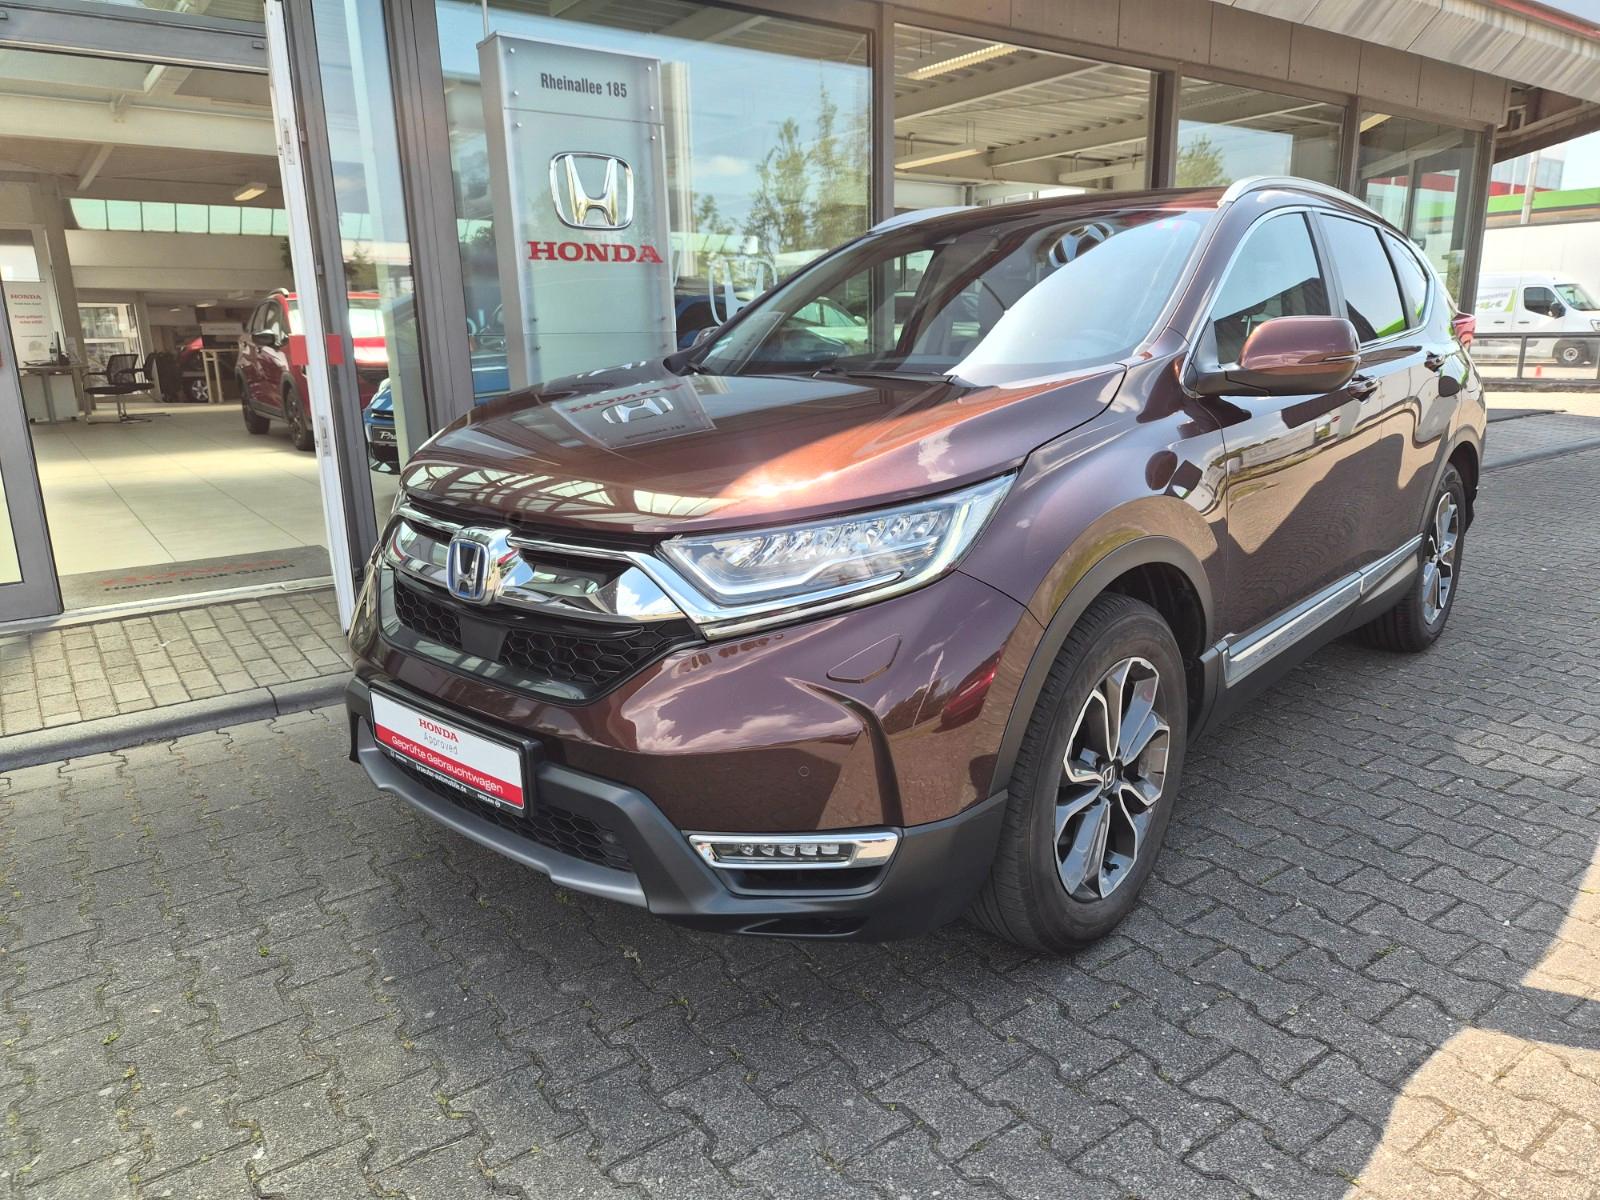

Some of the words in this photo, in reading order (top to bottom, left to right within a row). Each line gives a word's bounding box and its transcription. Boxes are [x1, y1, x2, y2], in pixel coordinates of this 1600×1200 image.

[540, 72, 602, 95] Rheinallee
[606, 81, 628, 98] 185
[527, 241, 664, 264] HONDA
[418, 718, 460, 743] HONDA
[423, 731, 458, 756] Approved
[391, 735, 427, 760] Geprüfte
[426, 752, 504, 795] Gebrauchtwagen
